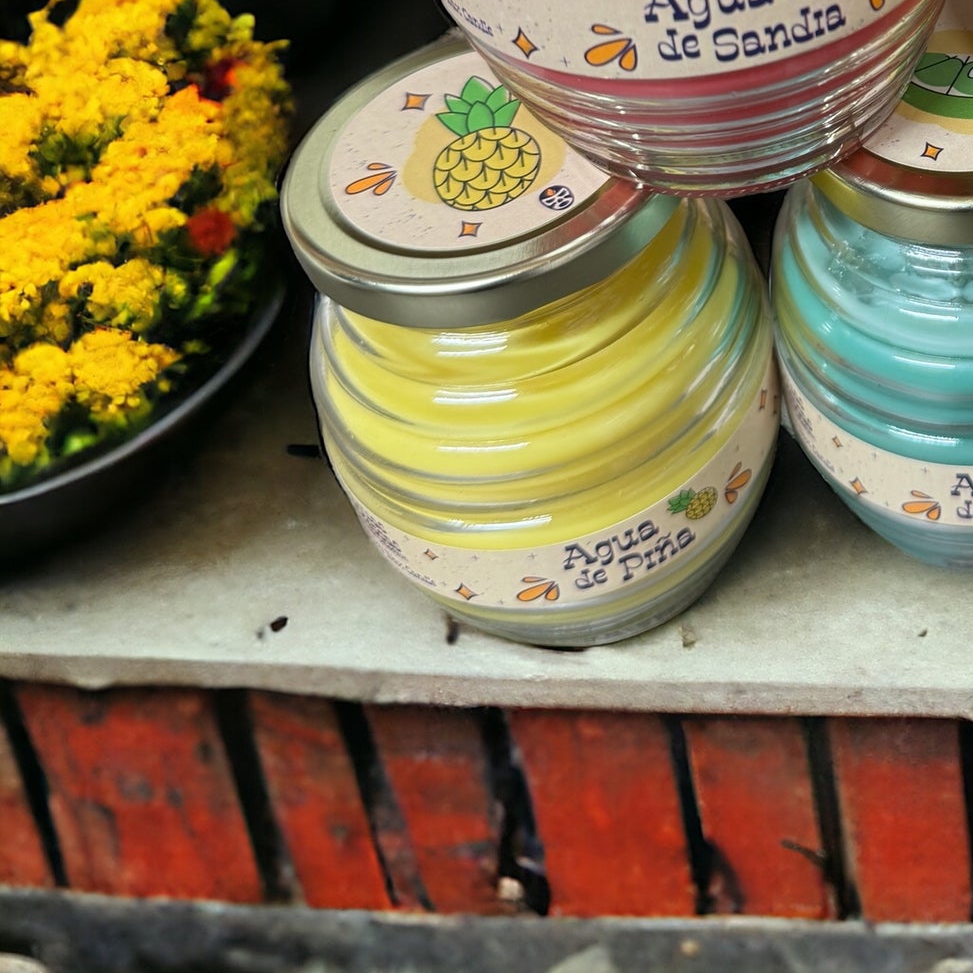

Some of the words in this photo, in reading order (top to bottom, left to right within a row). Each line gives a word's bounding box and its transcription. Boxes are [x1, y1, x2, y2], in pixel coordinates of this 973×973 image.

[657, 29, 701, 61] de
[563, 519, 660, 570] Agua
[574, 568, 609, 590] de
[618, 527, 696, 581] Piña
